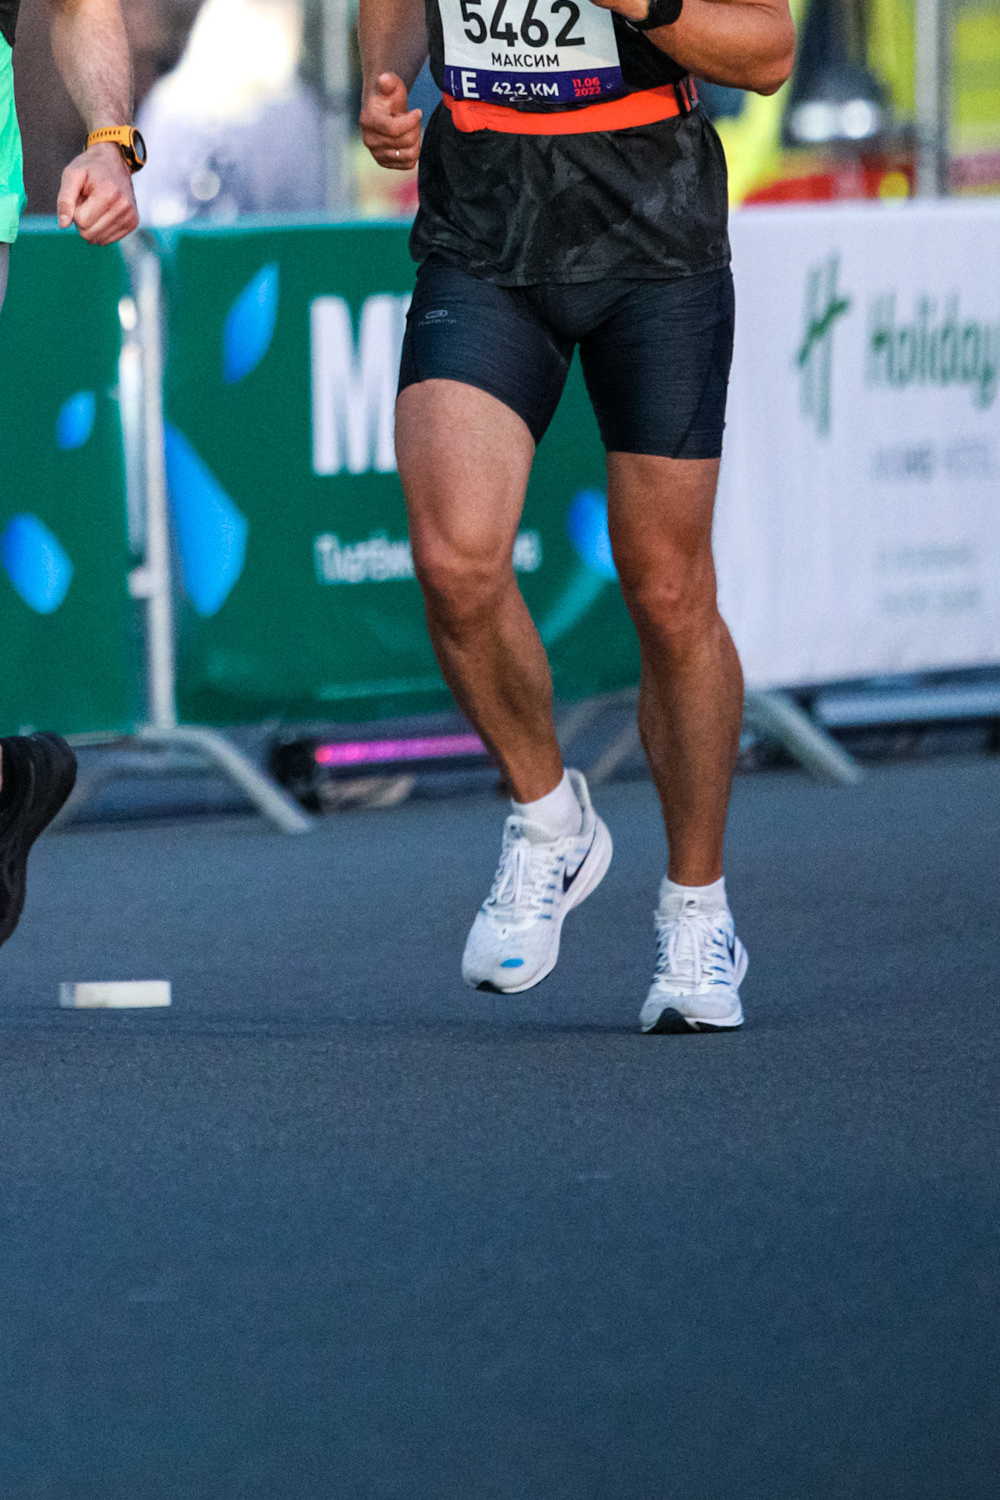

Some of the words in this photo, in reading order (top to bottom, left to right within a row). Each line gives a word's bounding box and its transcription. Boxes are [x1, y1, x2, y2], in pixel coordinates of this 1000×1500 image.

[491, 52, 560, 68] МАКСИМ
[461, 70, 480, 99] E
[491, 81, 528, 97] 42,2
[530, 82, 560, 97] КМ
[572, 77, 600, 89] 11.06
[574, 86, 601, 98] 2022
